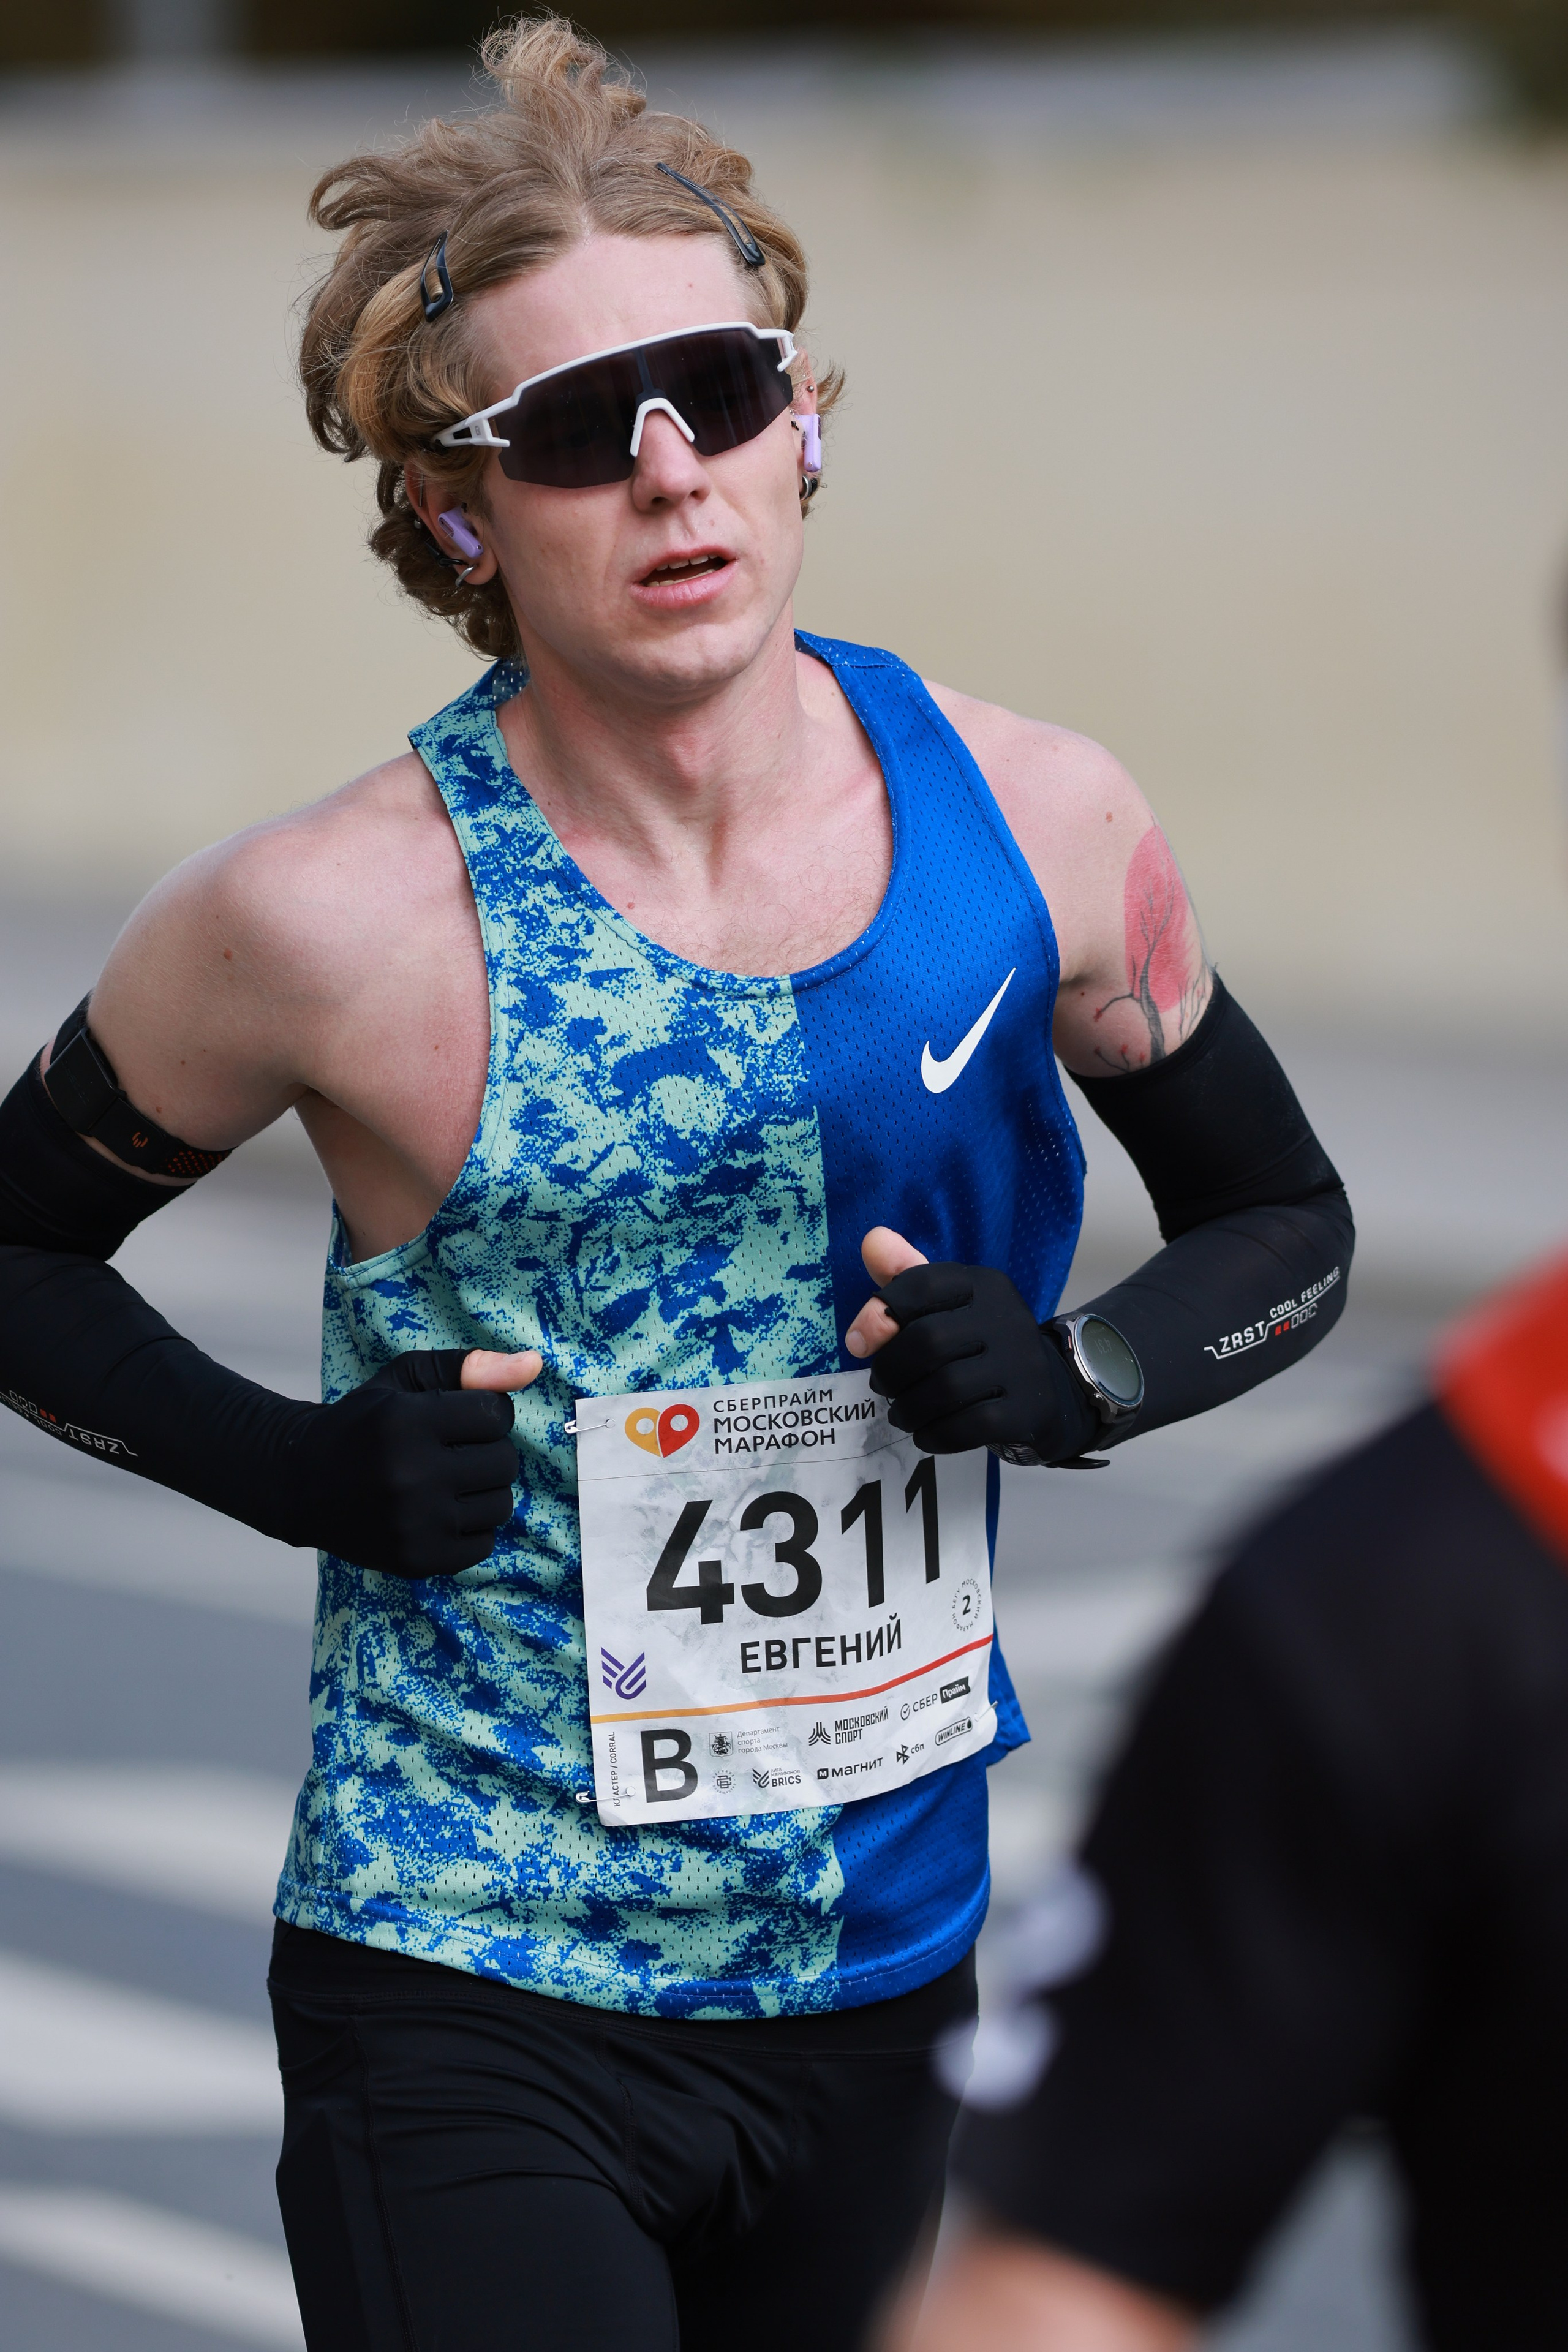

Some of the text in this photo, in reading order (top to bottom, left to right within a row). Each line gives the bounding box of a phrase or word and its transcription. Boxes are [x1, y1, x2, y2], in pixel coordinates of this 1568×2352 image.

[1270, 1266, 1340, 1318] COOL FEELING
[1219, 1321, 1265, 1353] ZRST
[713, 1388, 833, 1412] СБЕРПРАЙМ
[714, 1398, 875, 1434] МОСКОВСКИЙ
[69, 1428, 119, 1455] ZRST
[715, 1428, 835, 1454] МАРАФОН
[646, 1455, 940, 1625] 4311
[962, 1594, 971, 1616] 2
[740, 1612, 902, 1673] ЕВГЕНИЙ
[913, 1684, 966, 1712] СБЕР Прайм
[835, 1706, 888, 1732] МОСКОВСКИЙ
[737, 1727, 780, 1738] Департамент
[835, 1728, 862, 1744] СПОРТ
[938, 1722, 965, 1743] WINLINE
[608, 1732, 617, 1763] CORRAL
[910, 1743, 924, 1754] сбп
[772, 1775, 802, 1787] BRICS
